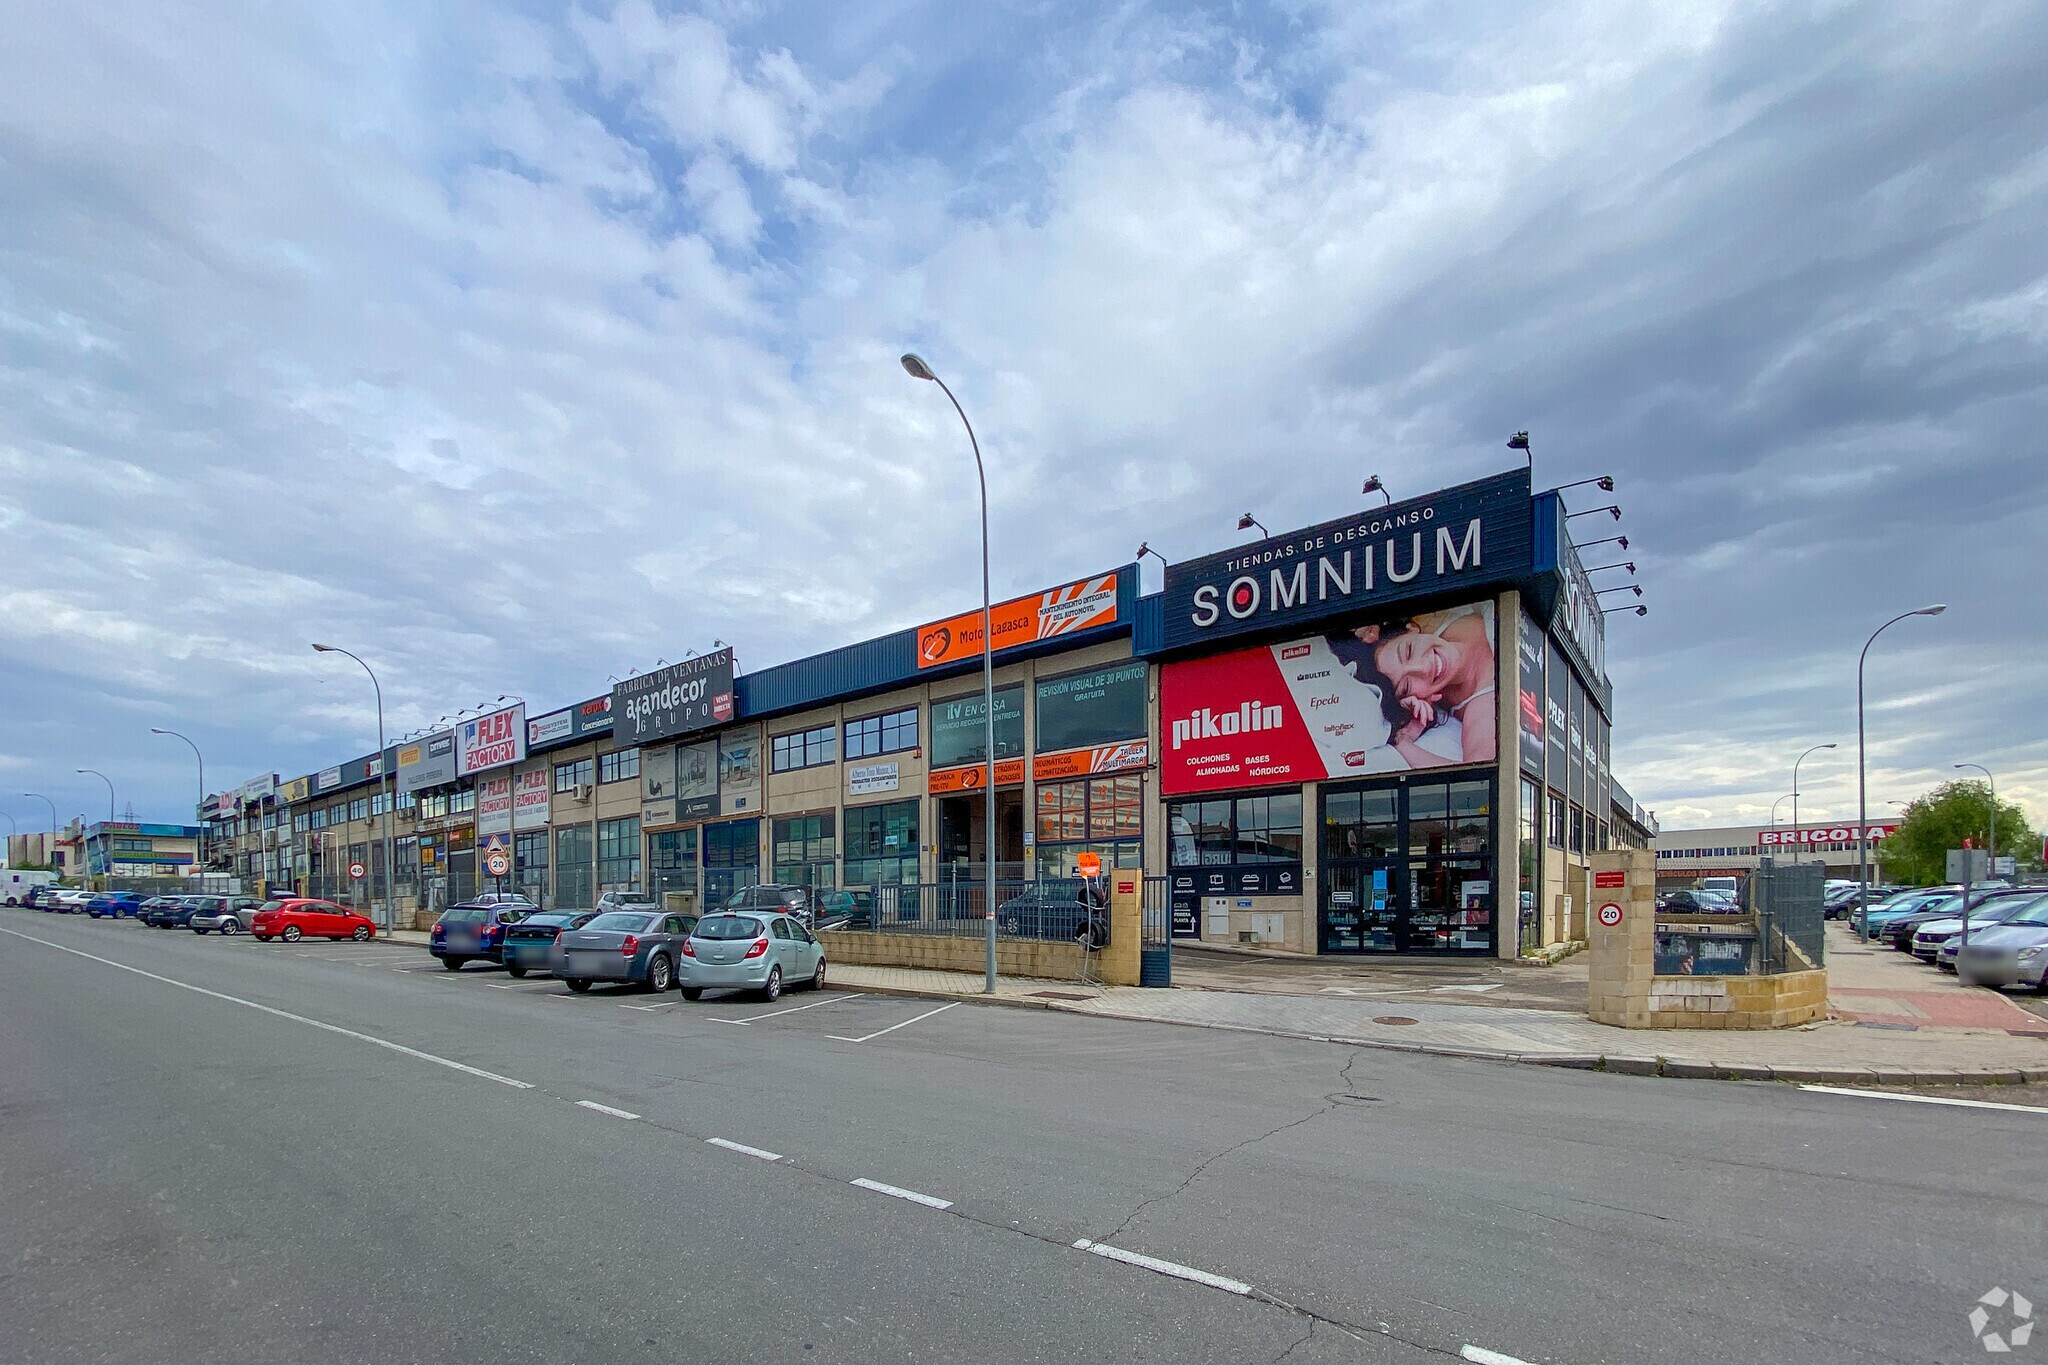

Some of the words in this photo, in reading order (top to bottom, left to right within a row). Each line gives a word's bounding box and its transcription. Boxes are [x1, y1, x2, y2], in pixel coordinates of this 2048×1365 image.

[1226, 544, 1294, 573] TIENDAS
[1304, 537, 1325, 552] DE
[1334, 507, 1434, 543] DESCANSO
[1191, 517, 1482, 627] SOMNIUM
[1039, 598, 1083, 616] MANTENIMIENTO
[1083, 591, 1111, 604] INTEGRAL
[991, 616, 1029, 636] Lagasca
[1053, 613, 1064, 621] DEL
[1283, 646, 1309, 659] pikolin
[617, 675, 655, 697] FABRICA
[657, 670, 670, 684] DE
[673, 650, 727, 679] VENTANAS
[1038, 683, 1069, 698] REVISIÓN
[1070, 679, 1094, 691] VISUAL
[1095, 674, 1105, 686] DE
[1106, 673, 1115, 684] 30
[1115, 666, 1145, 683] PUNTOS
[1304, 670, 1331, 680] BULTEX
[1074, 689, 1105, 702] GRATUITA
[1310, 693, 1340, 710] Epeda
[626, 677, 707, 734] afandecor
[964, 704, 978, 717] EN
[980, 698, 1006, 714] CSA
[581, 715, 614, 732] Concesionario
[640, 702, 708, 733] GRUPO
[935, 721, 960, 732] SERVICIO
[960, 716, 987, 727] RECOGID
[993, 710, 1021, 722] ENTREGA
[1172, 700, 1283, 750] pikolin
[478, 710, 515, 746] FLEX
[466, 741, 515, 770] FACTORY
[1120, 745, 1145, 757] TALLER
[1186, 753, 1231, 766] COLCHONES
[1245, 754, 1270, 765] BASES
[1034, 756, 1072, 768] NEUMÁTICOS
[1102, 756, 1145, 769] MULTIMARCA
[1034, 763, 1079, 777] CLIMATIZACIÓN
[1196, 764, 1241, 777] ALMOHADAS
[1249, 764, 1291, 777] NÓRDICOS
[488, 777, 509, 796] FLEX
[523, 770, 547, 790] FLEX
[480, 798, 510, 814] FACTORY
[515, 791, 548, 807] FACTORY
[492, 860, 504, 869] 20
[1603, 911, 1617, 919] 20
